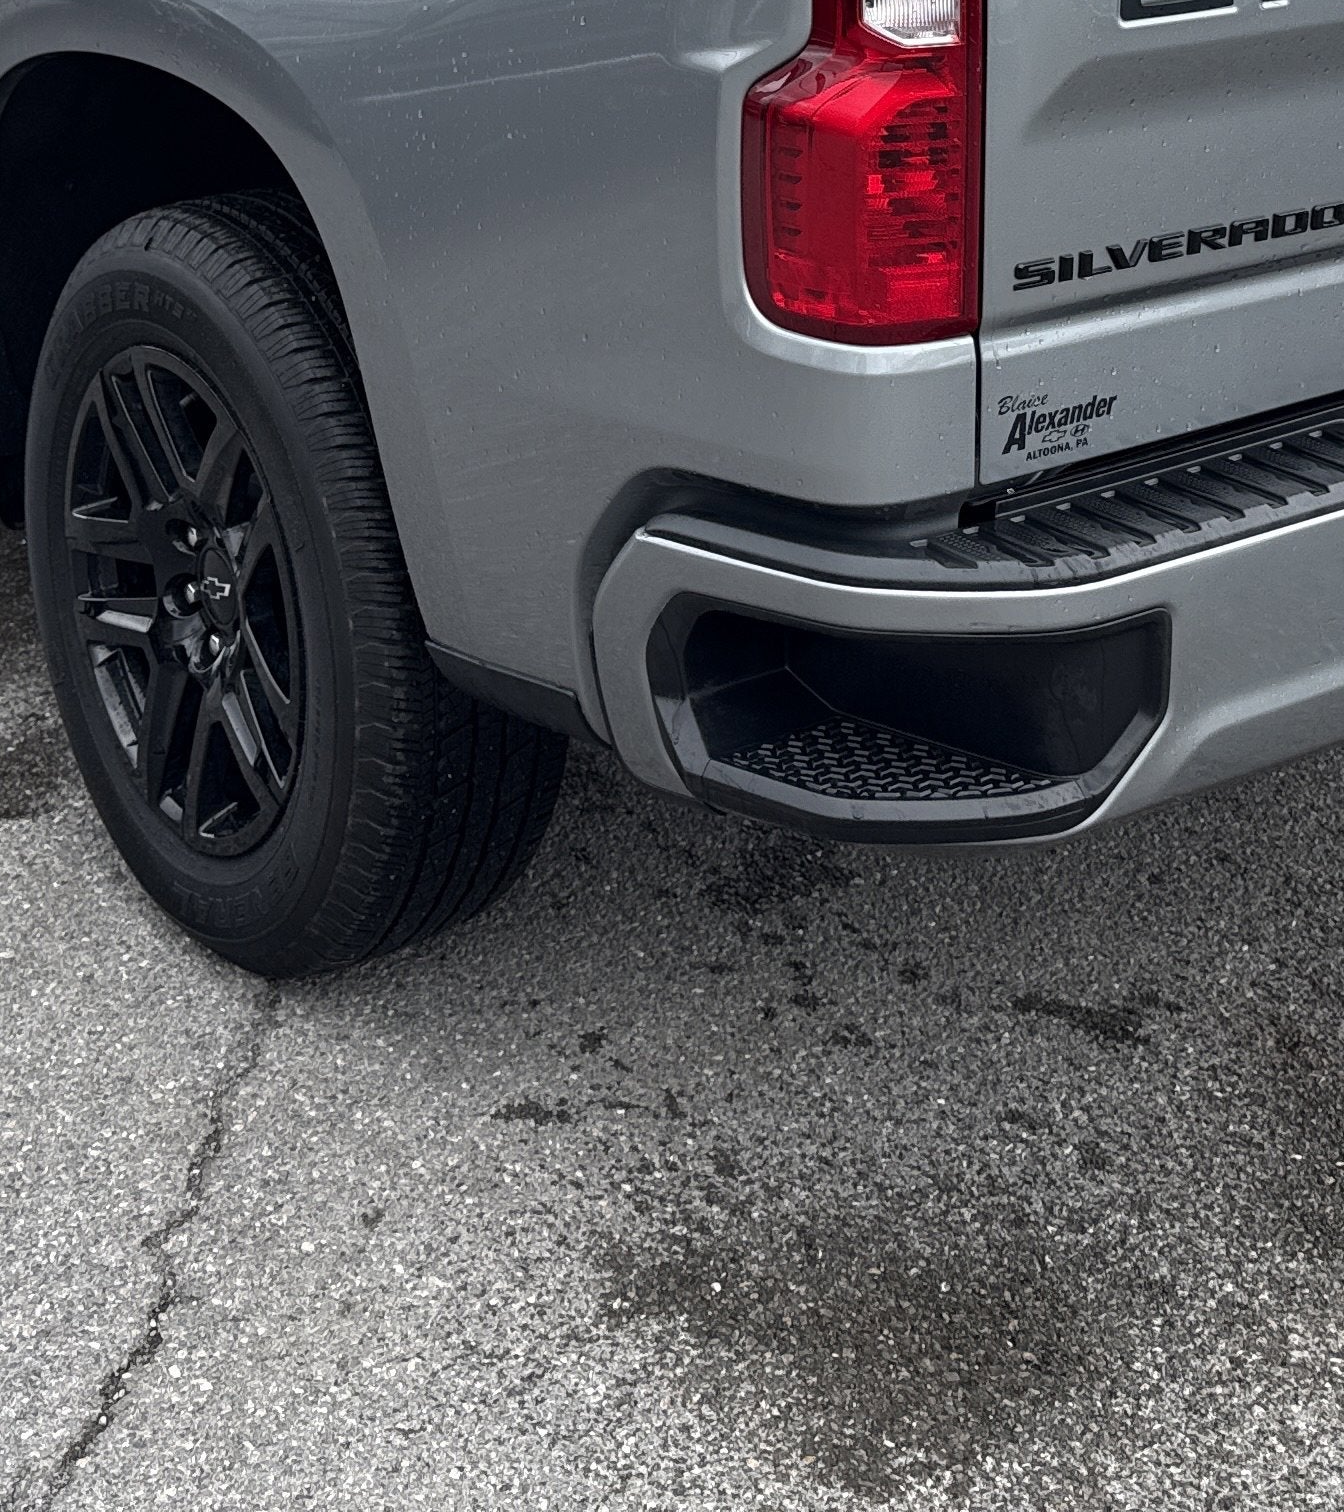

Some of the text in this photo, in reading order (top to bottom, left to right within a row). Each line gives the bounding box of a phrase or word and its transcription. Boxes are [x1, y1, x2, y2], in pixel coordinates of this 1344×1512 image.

[1001, 394, 1118, 455] Alexander
[1025, 436, 1089, 462] ALTOONA, PA
